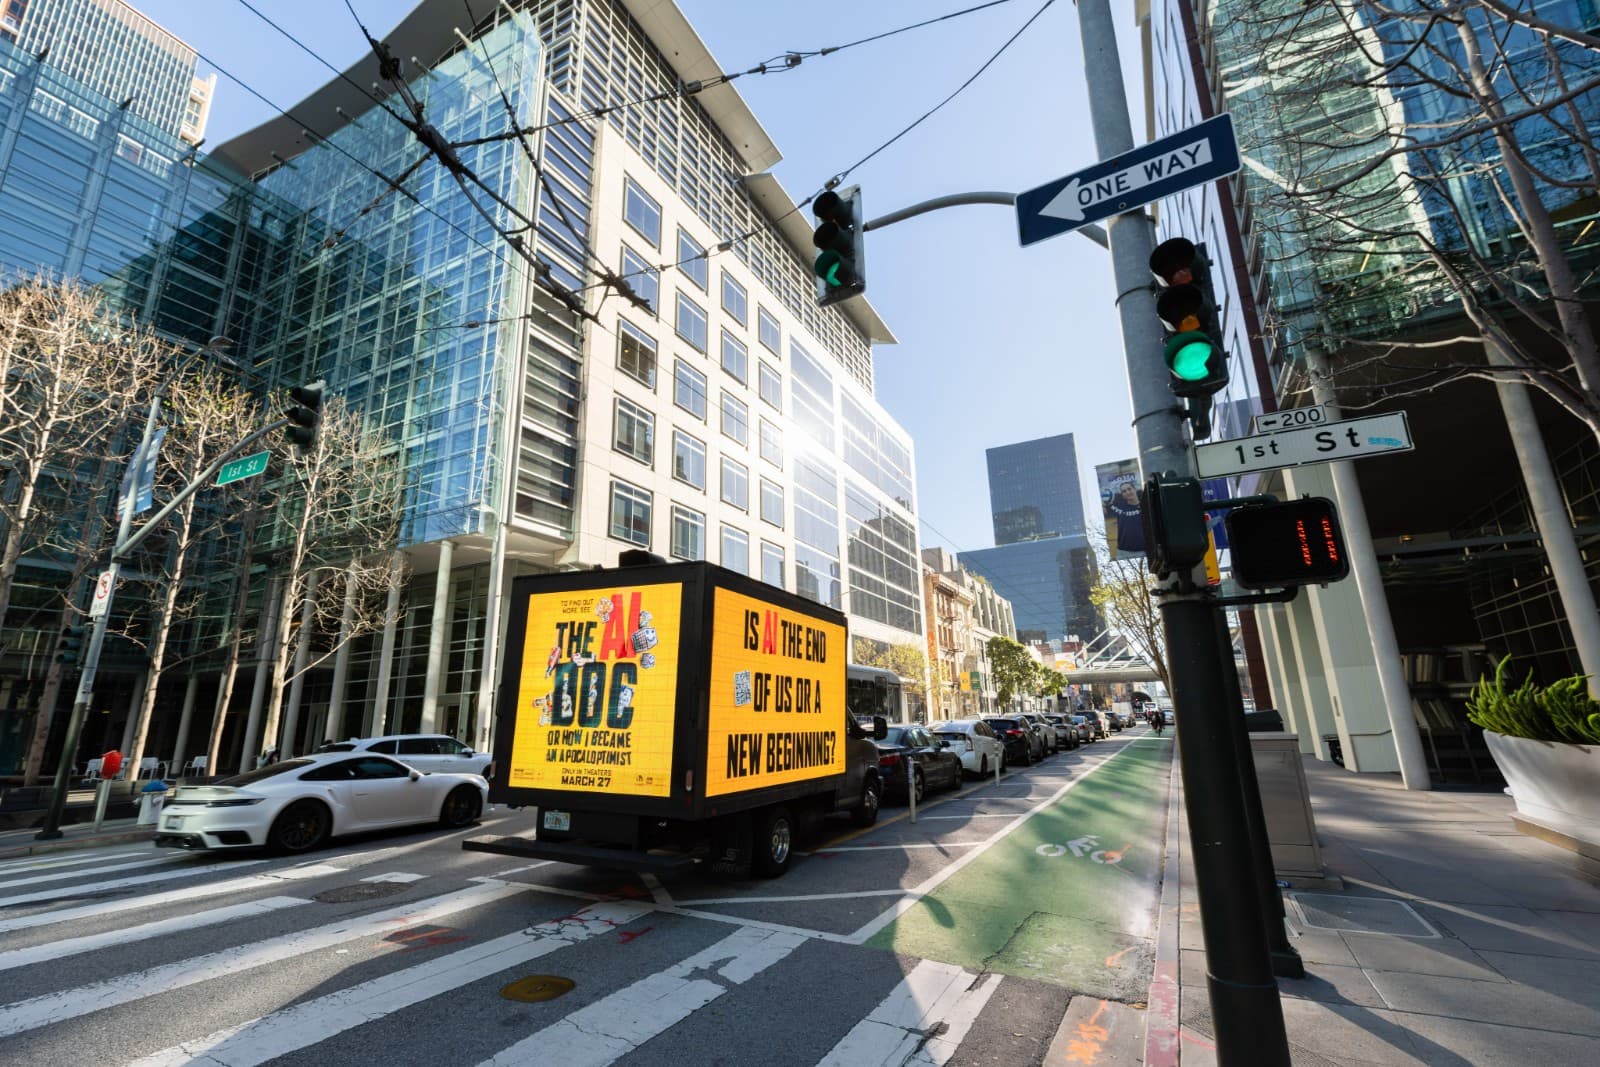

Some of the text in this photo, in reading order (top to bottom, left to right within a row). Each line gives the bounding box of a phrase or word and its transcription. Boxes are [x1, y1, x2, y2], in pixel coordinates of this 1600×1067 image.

[1078, 144, 1202, 205] ONE WAY
[1281, 409, 1320, 427] 200
[1236, 427, 1360, 464] 1st St
[228, 460, 258, 478] 1st St
[1297, 517, 1338, 566] 11
[583, 598, 594, 606] OUT
[556, 592, 642, 660] THE AI
[744, 609, 826, 663] IS AI THE END
[551, 662, 638, 729] DOC
[754, 672, 821, 713] OF US OR A
[547, 728, 632, 749] OR HOW I BECAME
[727, 731, 836, 779] NEW BEGINNING?
[546, 749, 632, 766] AN APOCALOPTIMIST
[561, 767, 575, 775] ONLY
[584, 768, 612, 777] THEATERS
[561, 776, 611, 788] MARCH 27
